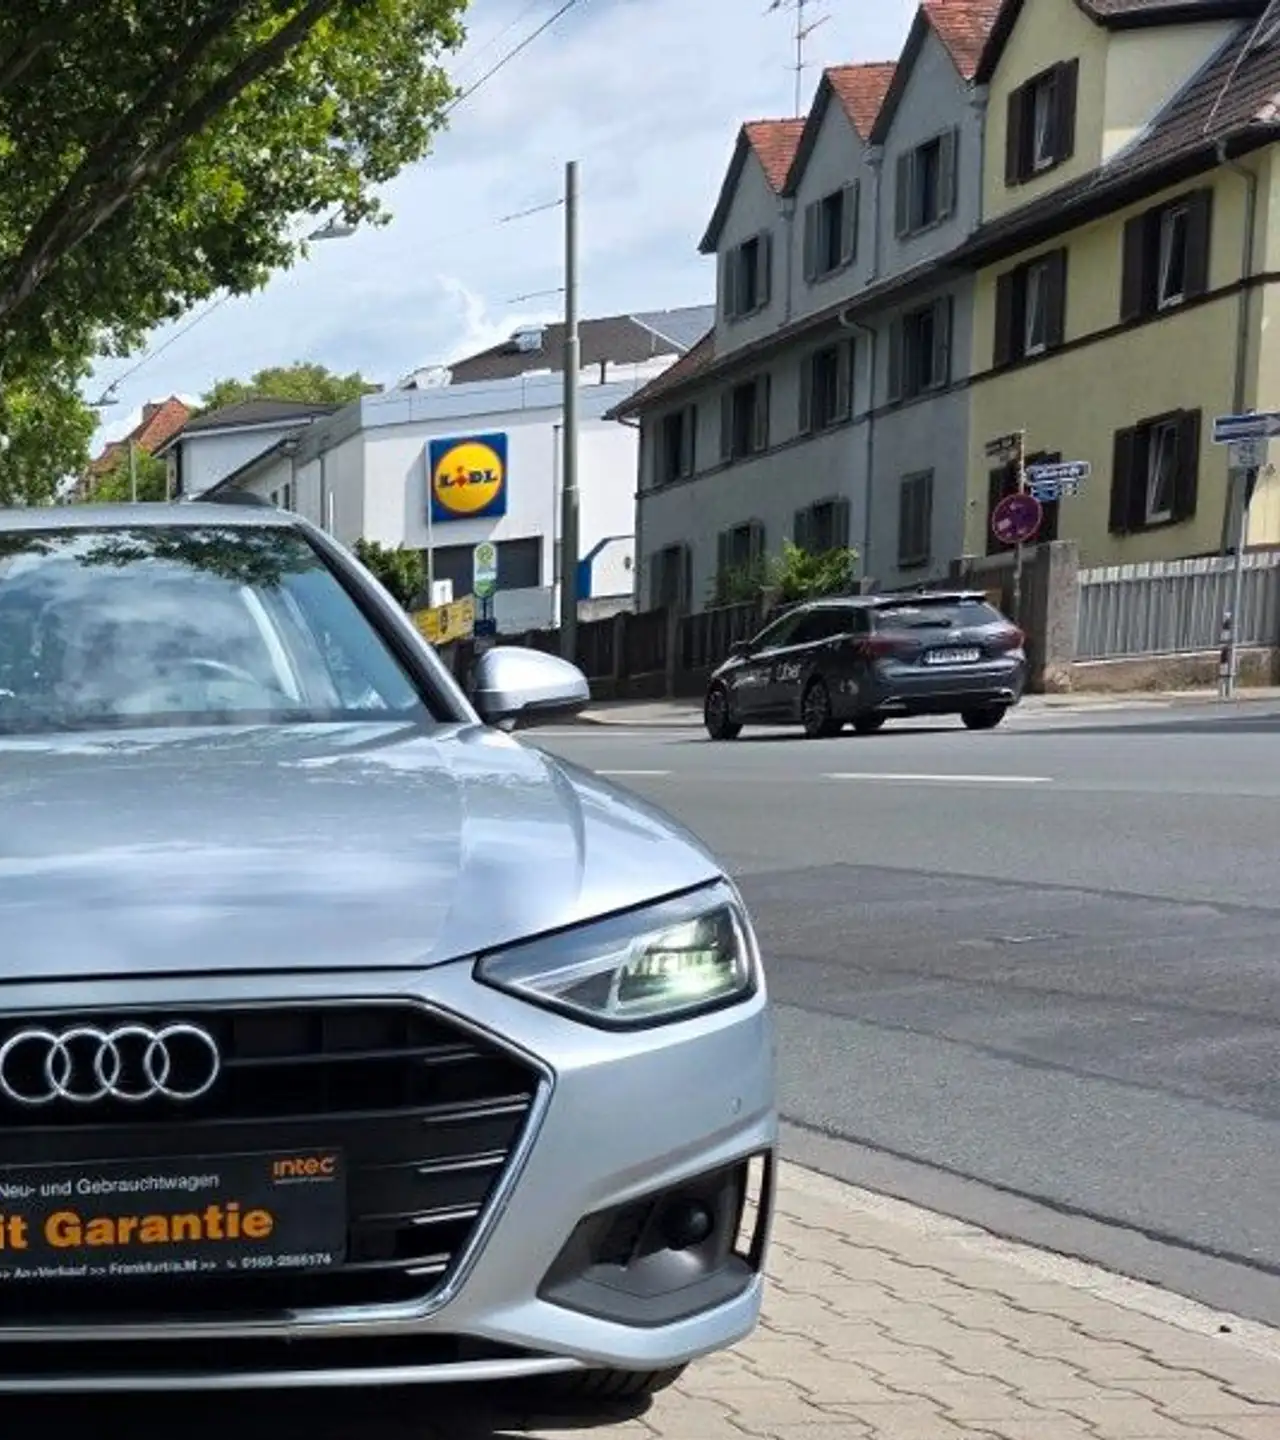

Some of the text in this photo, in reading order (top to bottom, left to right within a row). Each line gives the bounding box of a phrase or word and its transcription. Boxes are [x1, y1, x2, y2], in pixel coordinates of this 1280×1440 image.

[40, 1180, 72, 1197] und
[75, 1174, 220, 1195] Gebrauchtwagen
[44, 1202, 274, 1248] Garantie
